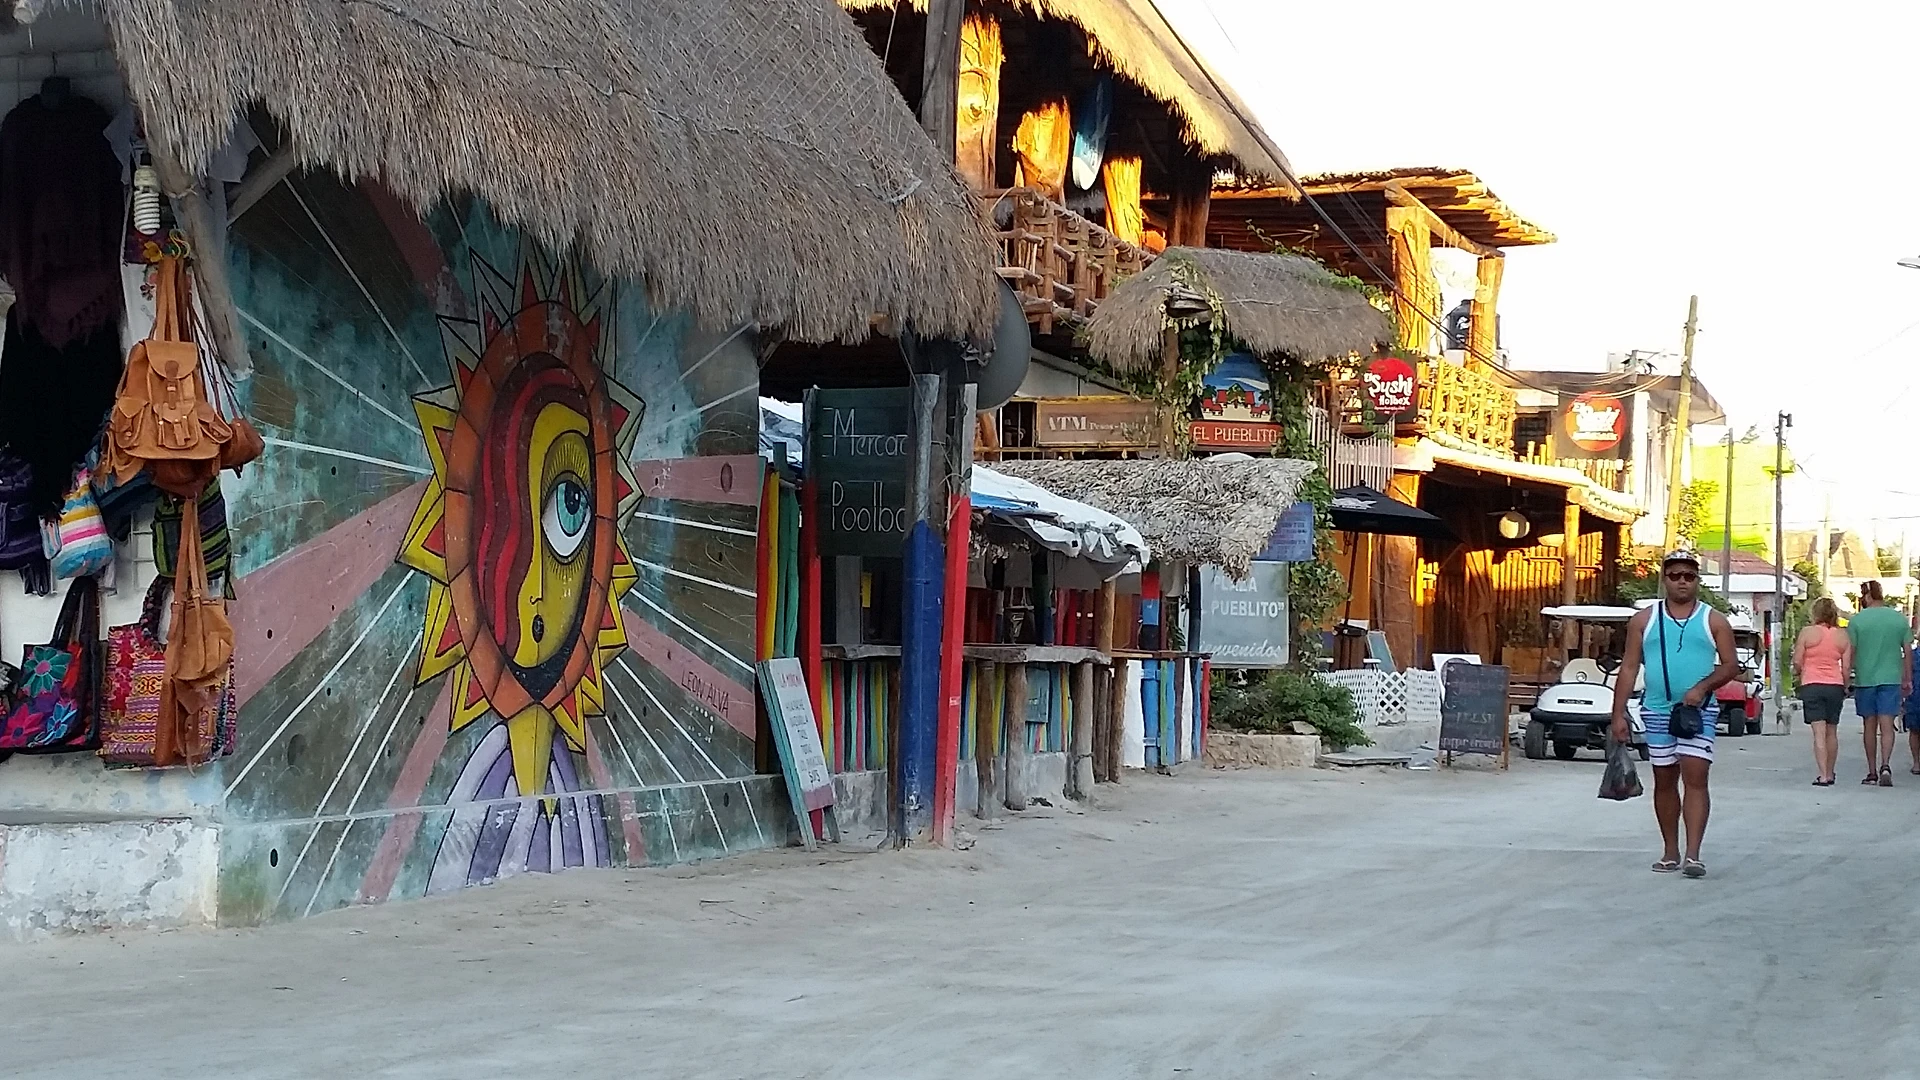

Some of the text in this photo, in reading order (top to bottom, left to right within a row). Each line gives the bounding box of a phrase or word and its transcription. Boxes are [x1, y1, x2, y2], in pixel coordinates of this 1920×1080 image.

[1368, 373, 1413, 397] Sushi
[1048, 416, 1087, 431] ATM
[1193, 426, 1277, 443] EL PUEBLITO
[1200, 639, 1282, 657] ienvenidos
[706, 683, 729, 718] ALVA
